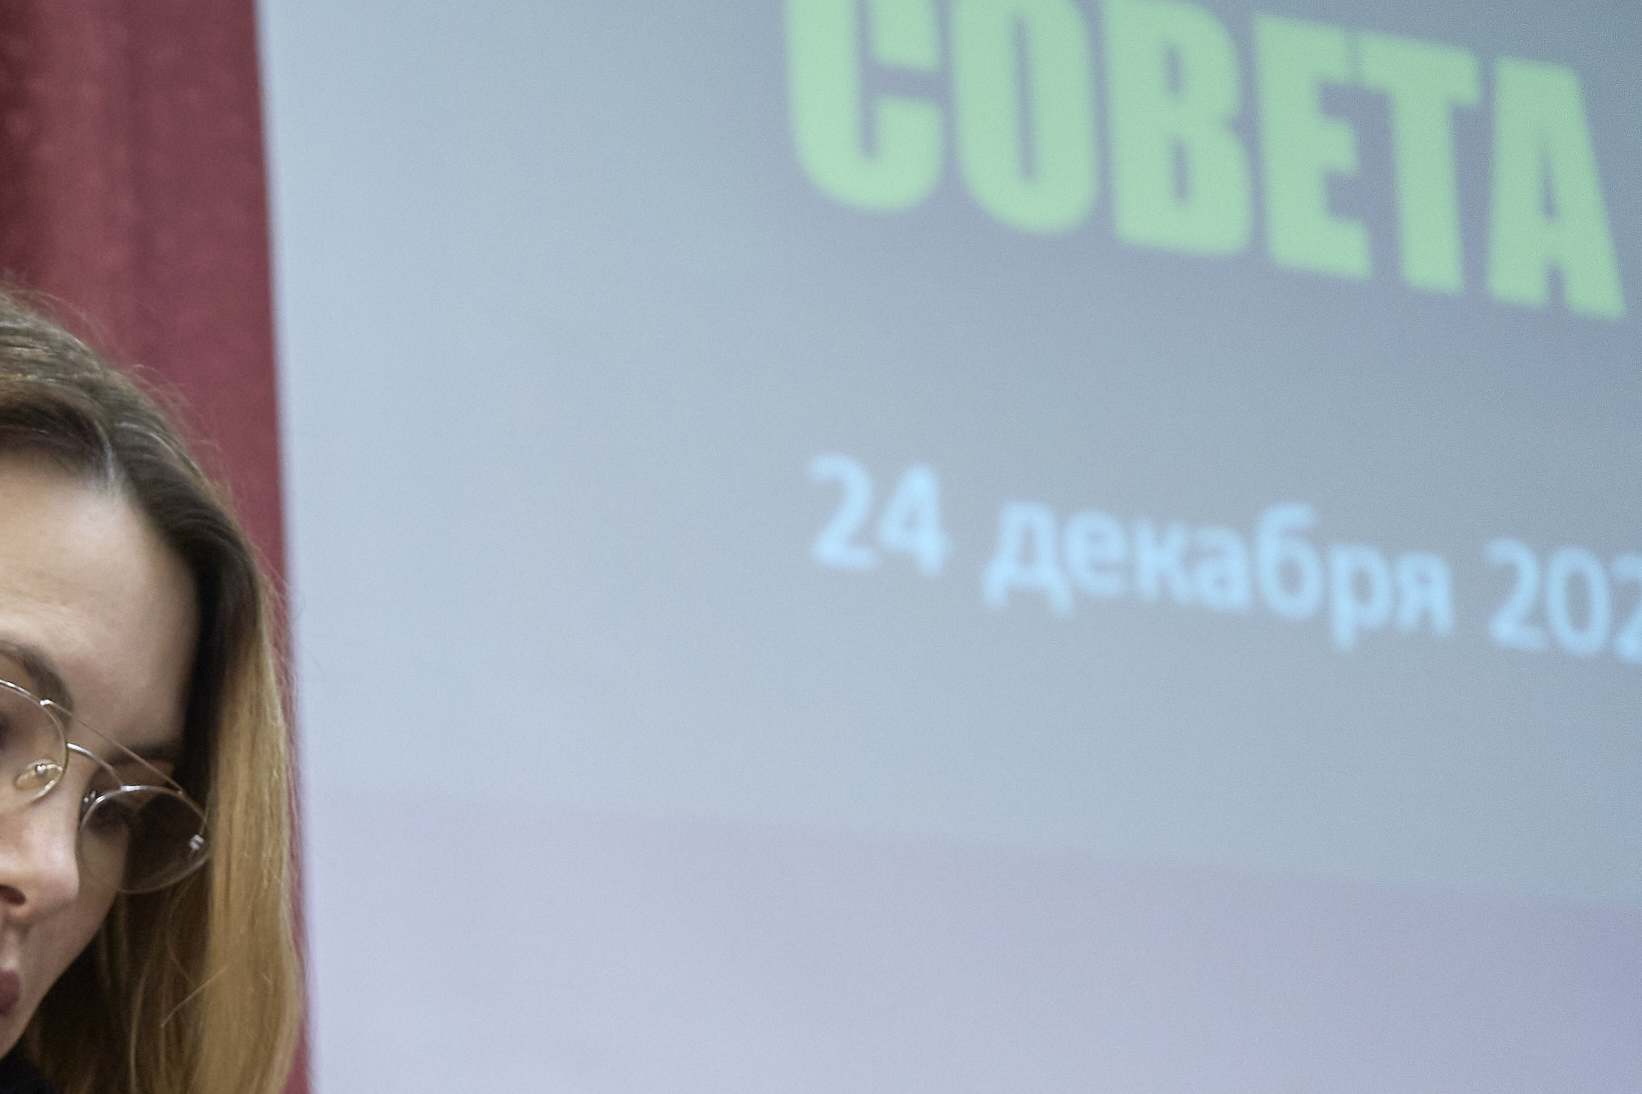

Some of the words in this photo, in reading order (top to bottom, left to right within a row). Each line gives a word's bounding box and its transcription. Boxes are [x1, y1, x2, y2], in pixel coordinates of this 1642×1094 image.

[784, 0, 1625, 321] СОВЕТА
[808, 453, 948, 576] 24
[982, 500, 1454, 652] декабря
